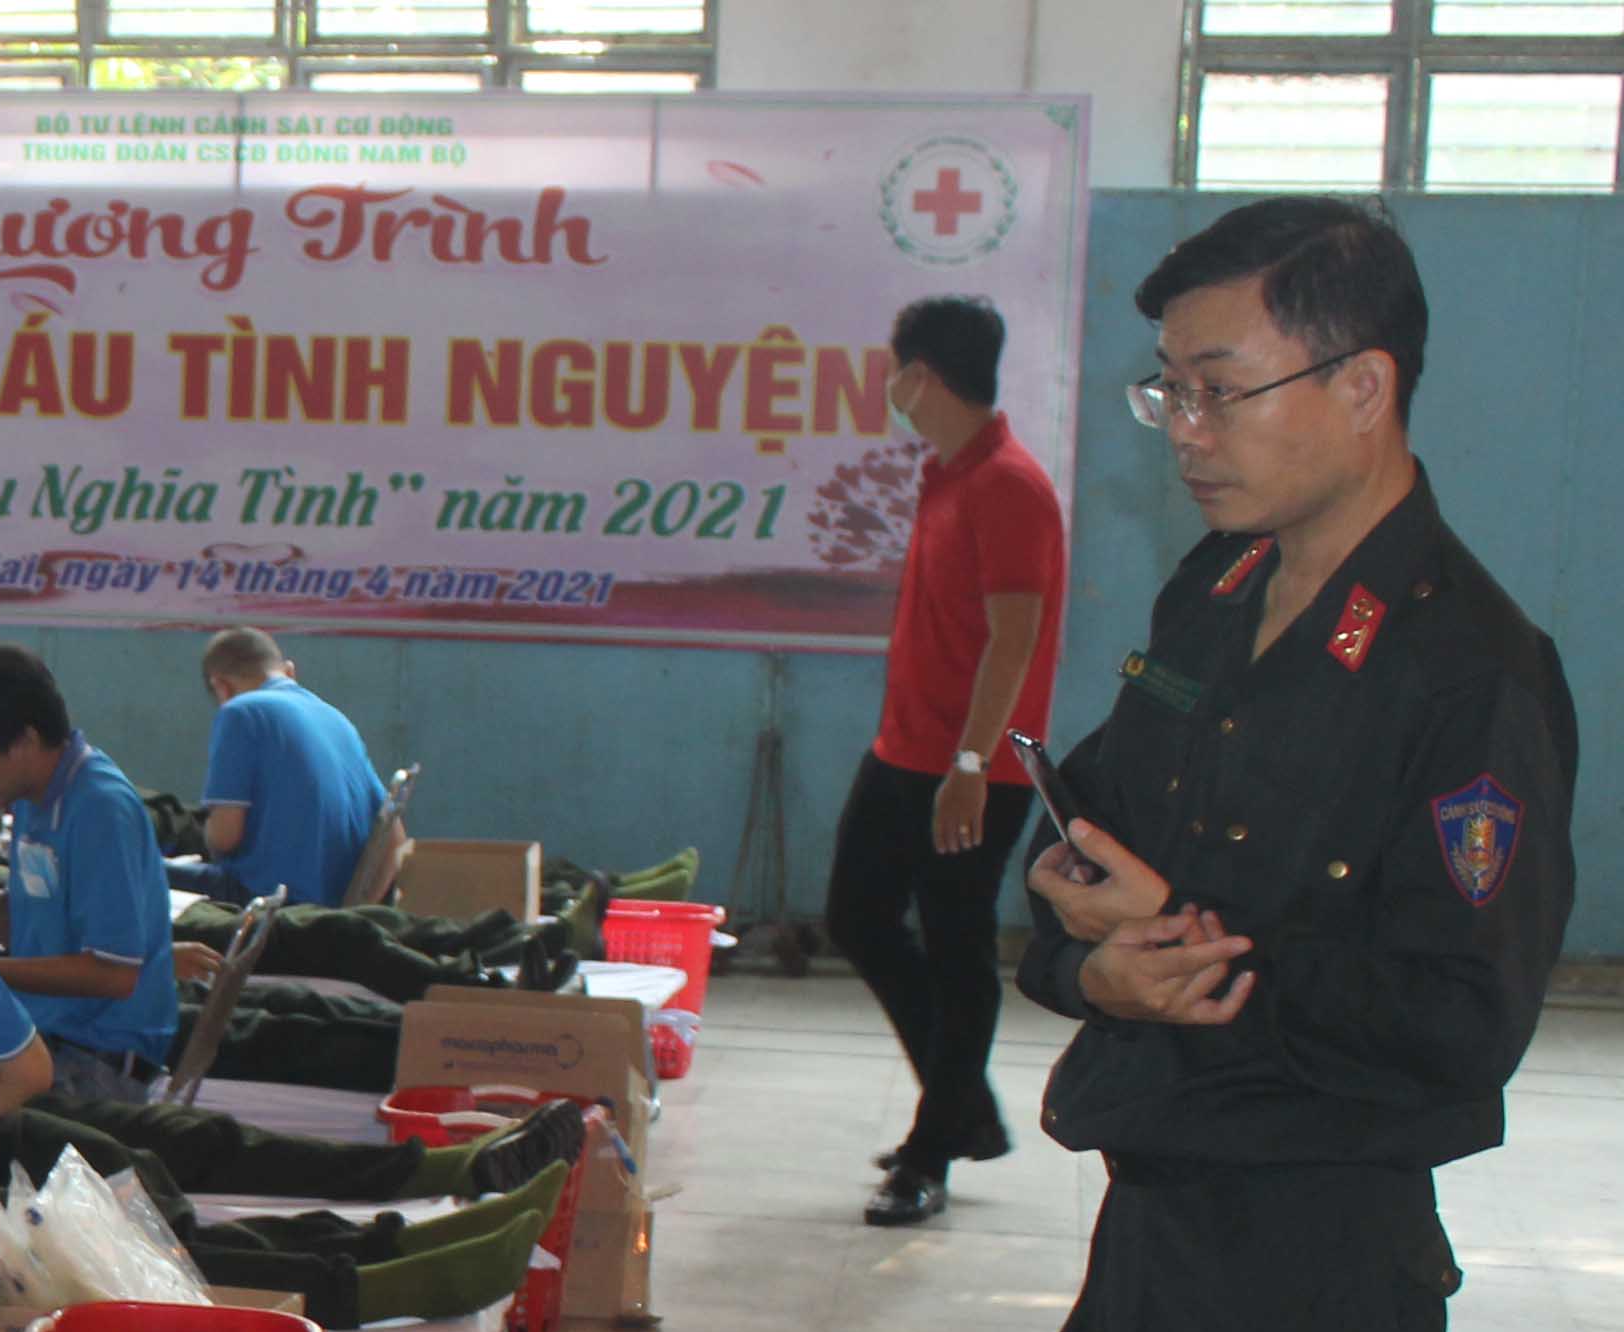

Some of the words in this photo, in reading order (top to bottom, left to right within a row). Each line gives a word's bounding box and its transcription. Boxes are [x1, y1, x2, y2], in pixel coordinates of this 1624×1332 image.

[23, 142, 106, 161] TRUNG
[359, 143, 421, 162] NAM
[285, 183, 609, 266] Trình
[169, 316, 409, 424] TÌNH
[447, 326, 891, 453] NGUYỆN
[31, 466, 219, 534] Nghĩa
[436, 479, 588, 534] năm
[602, 480, 787, 540] 2021
[59, 558, 161, 593] ngày
[174, 559, 222, 590] 14
[236, 561, 351, 598] tháng
[366, 566, 392, 596] 4
[403, 567, 499, 600] năm
[507, 569, 616, 604] 2021
